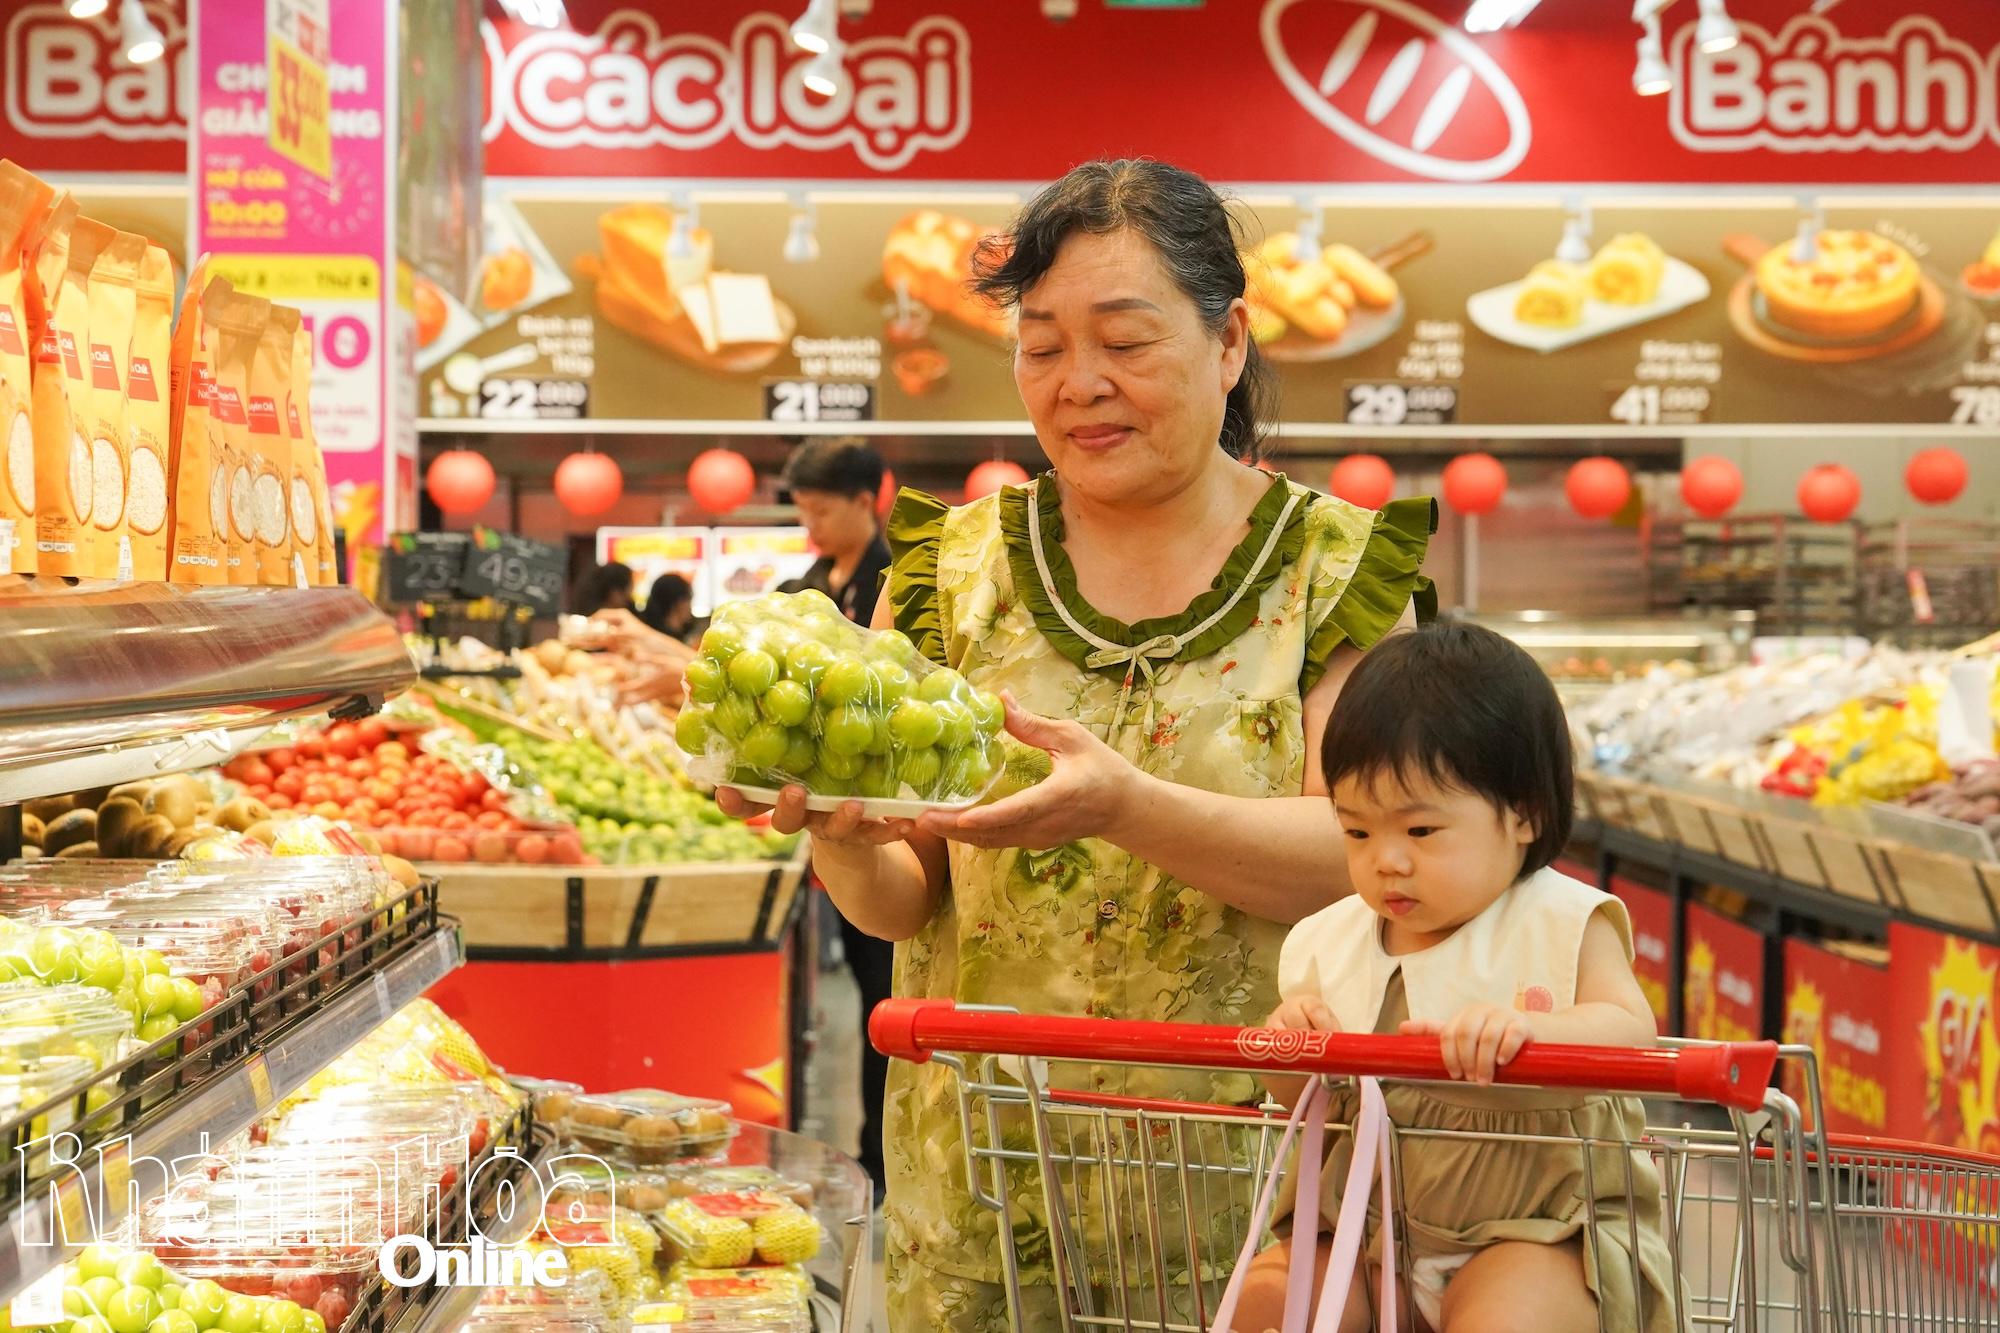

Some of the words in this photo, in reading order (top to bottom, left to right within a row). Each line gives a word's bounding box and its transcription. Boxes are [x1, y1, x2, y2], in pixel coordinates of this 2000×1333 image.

[515, 26, 722, 132] các
[746, 28, 956, 154] loại
[1686, 30, 1973, 136] Bánh
[481, 379, 539, 419] 22
[772, 382, 819, 420] 21
[1348, 384, 1406, 423] 29
[1610, 385, 1660, 424] 41
